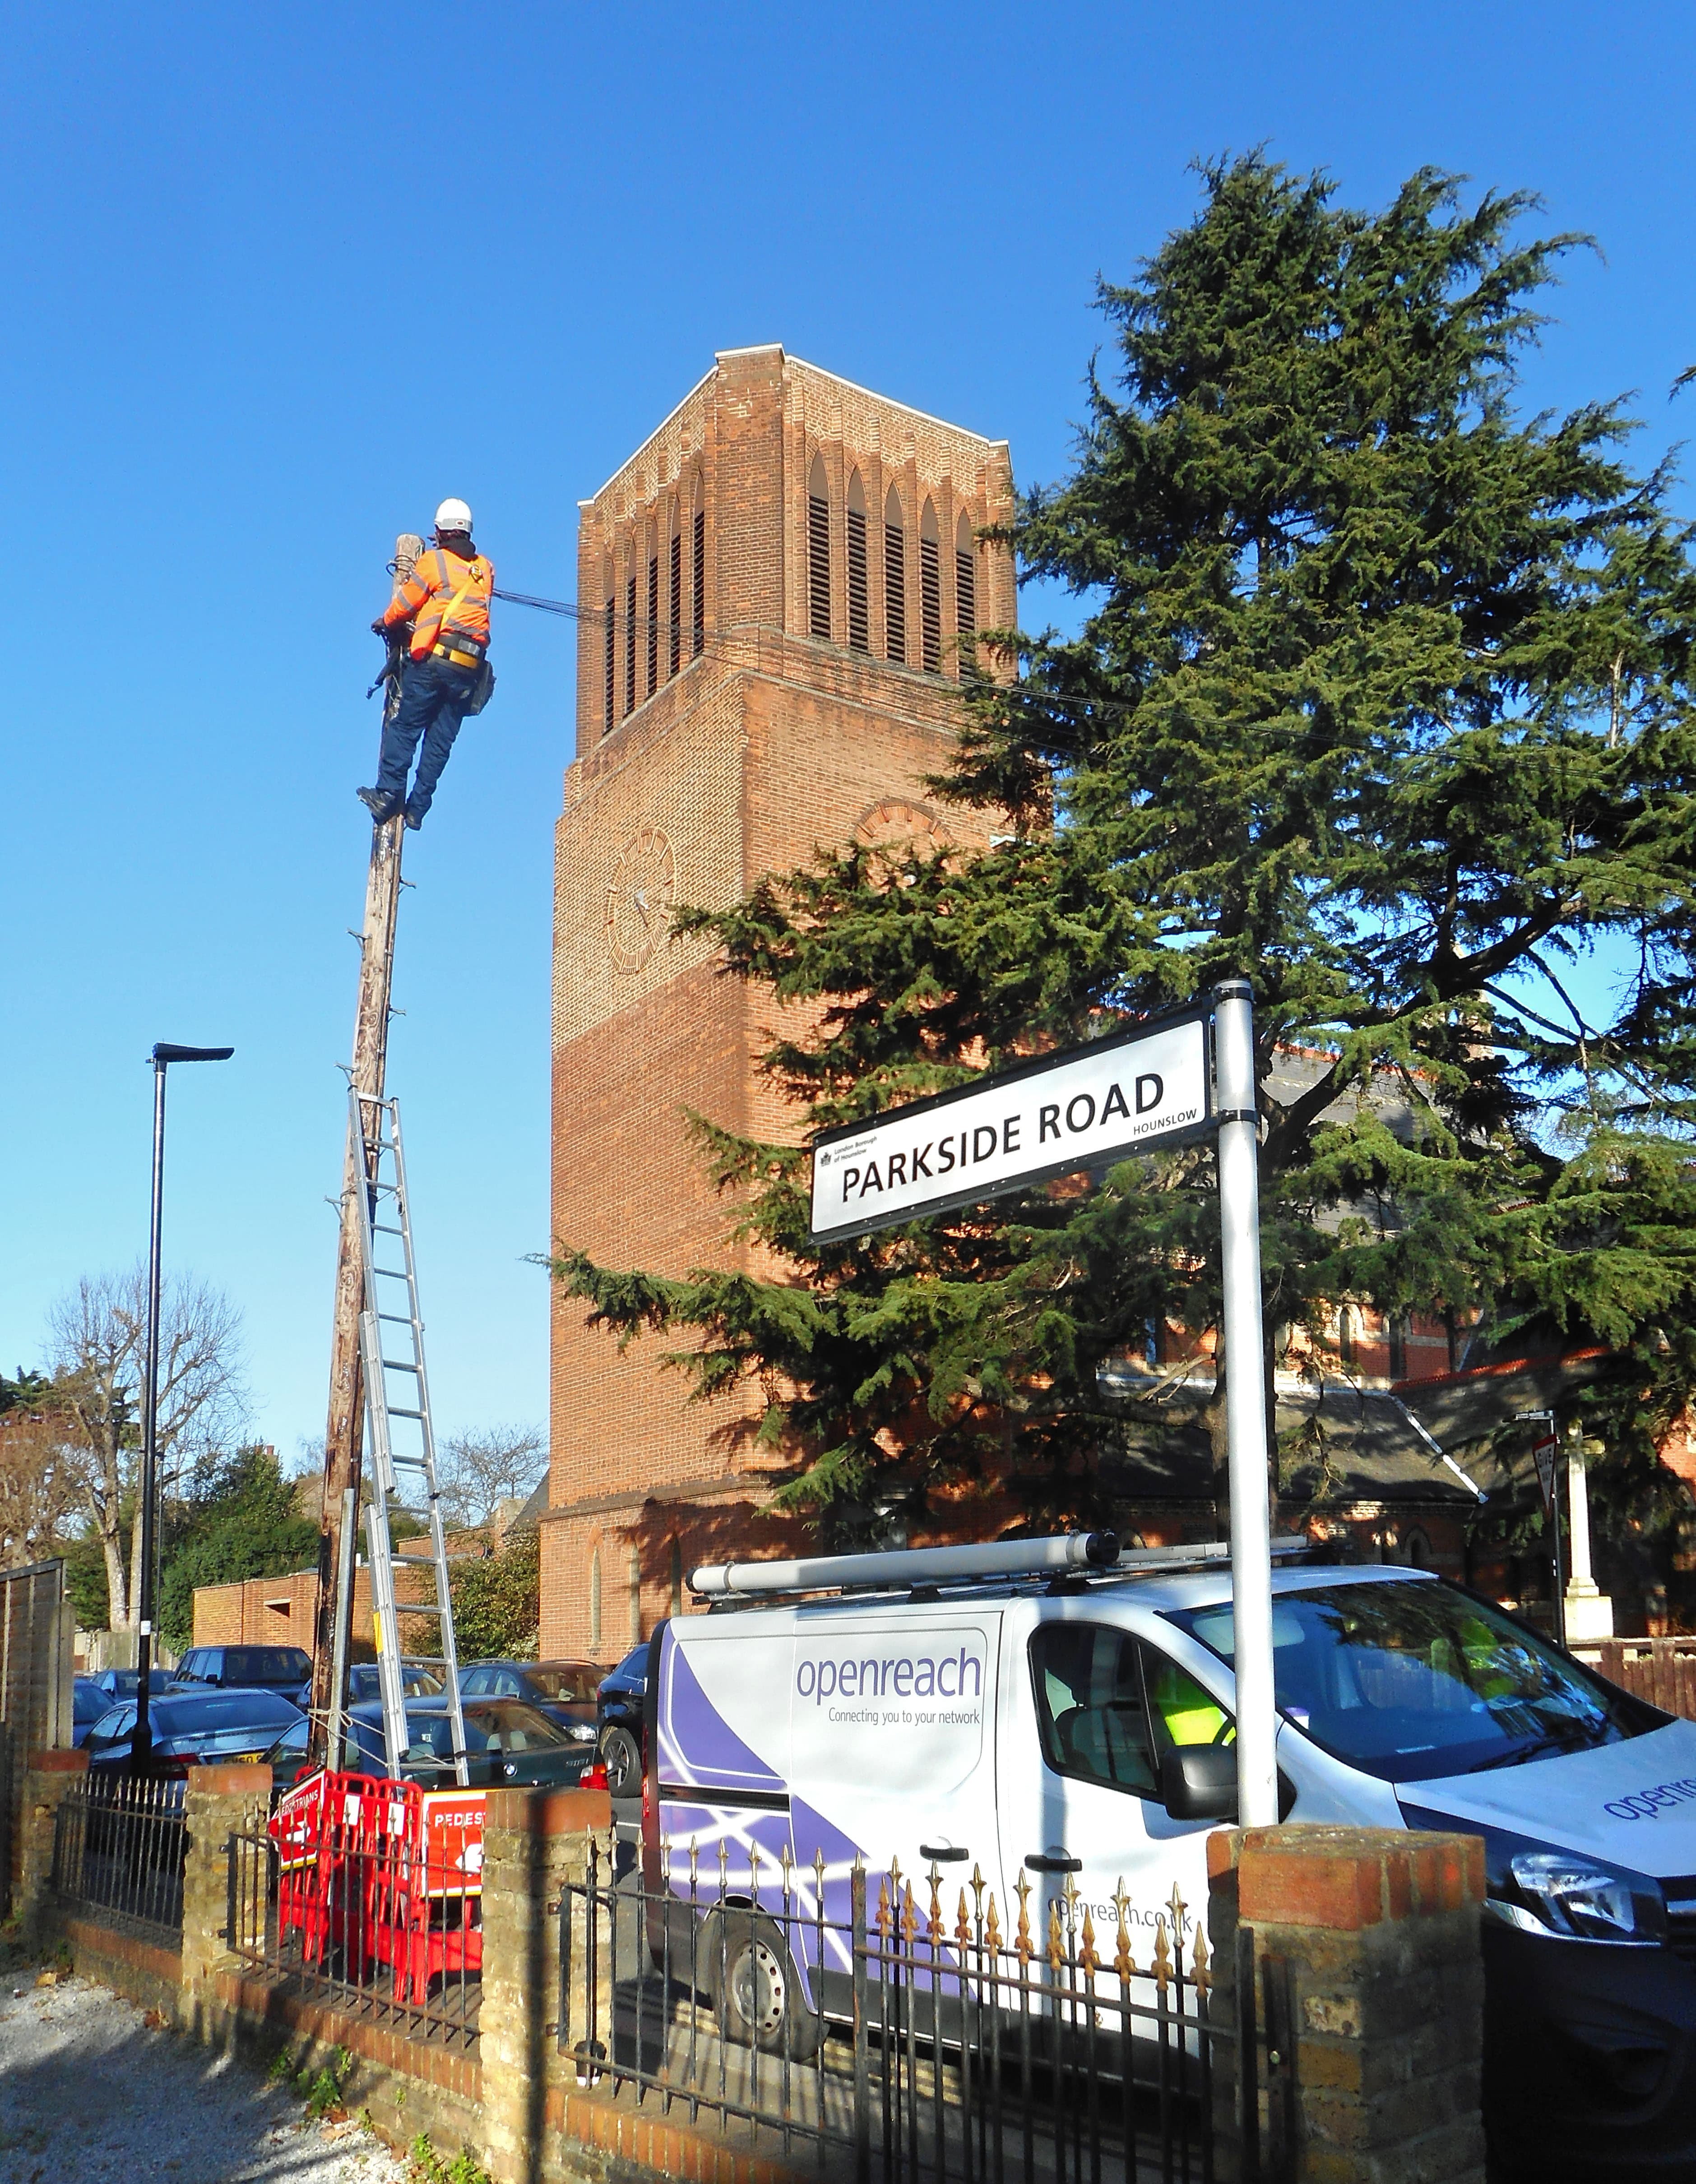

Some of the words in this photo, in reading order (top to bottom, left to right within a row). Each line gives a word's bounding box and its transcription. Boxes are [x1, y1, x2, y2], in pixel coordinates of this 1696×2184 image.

[1133, 1108, 1197, 1135] HOUNSLOW
[834, 1144, 854, 1155] London
[855, 1136, 877, 1148] Borough
[843, 1114, 1021, 1203] PARKSIDE
[1039, 1073, 1163, 1143] ROAD
[840, 1148, 867, 1161] Hounslow
[797, 1647, 981, 1706] openreach
[829, 1707, 879, 1726] Connecting
[882, 1712, 899, 1726] you
[902, 1710, 912, 1723] to
[915, 1711, 936, 1726] your
[939, 1708, 980, 1724] network
